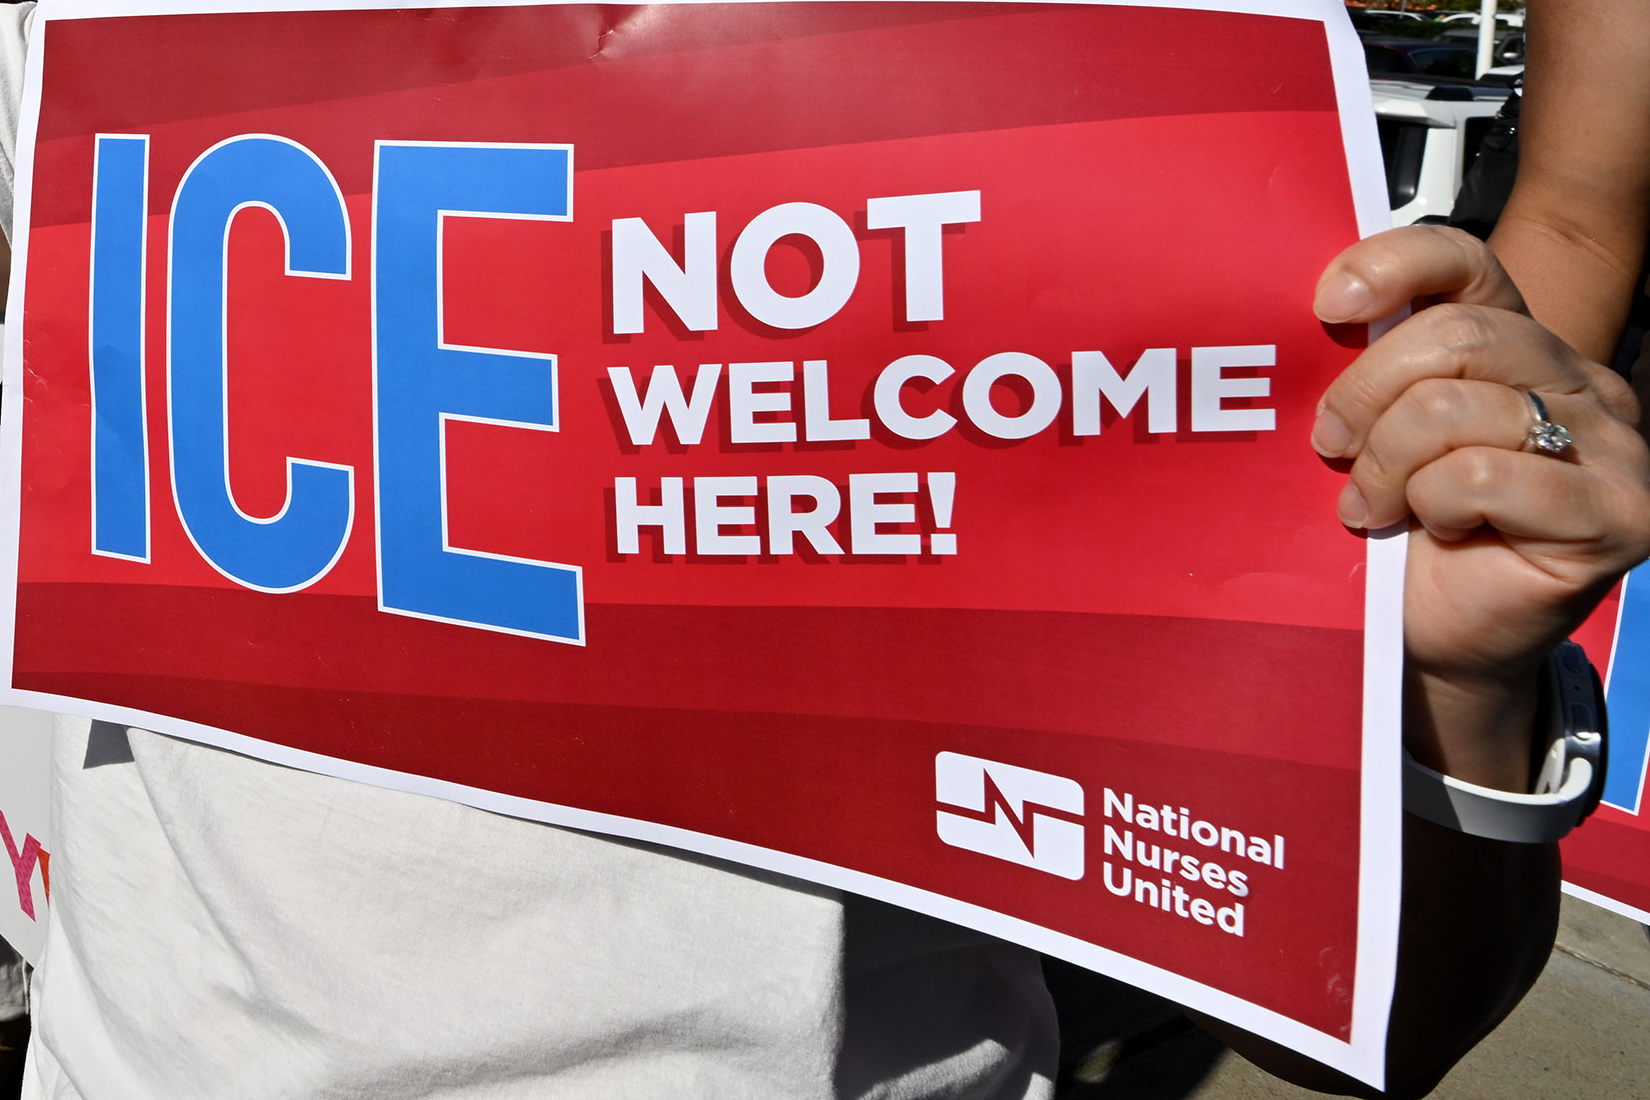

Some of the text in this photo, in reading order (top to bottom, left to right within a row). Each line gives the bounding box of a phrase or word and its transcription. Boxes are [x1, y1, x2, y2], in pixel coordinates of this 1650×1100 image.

[611, 190, 981, 335] NOT
[88, 133, 586, 647] ICE
[607, 344, 1277, 445] WELCOME
[615, 471, 957, 556] HERE!
[1103, 787, 1285, 870] National
[1103, 824, 1249, 898] Nurses
[1102, 861, 1245, 938] United
